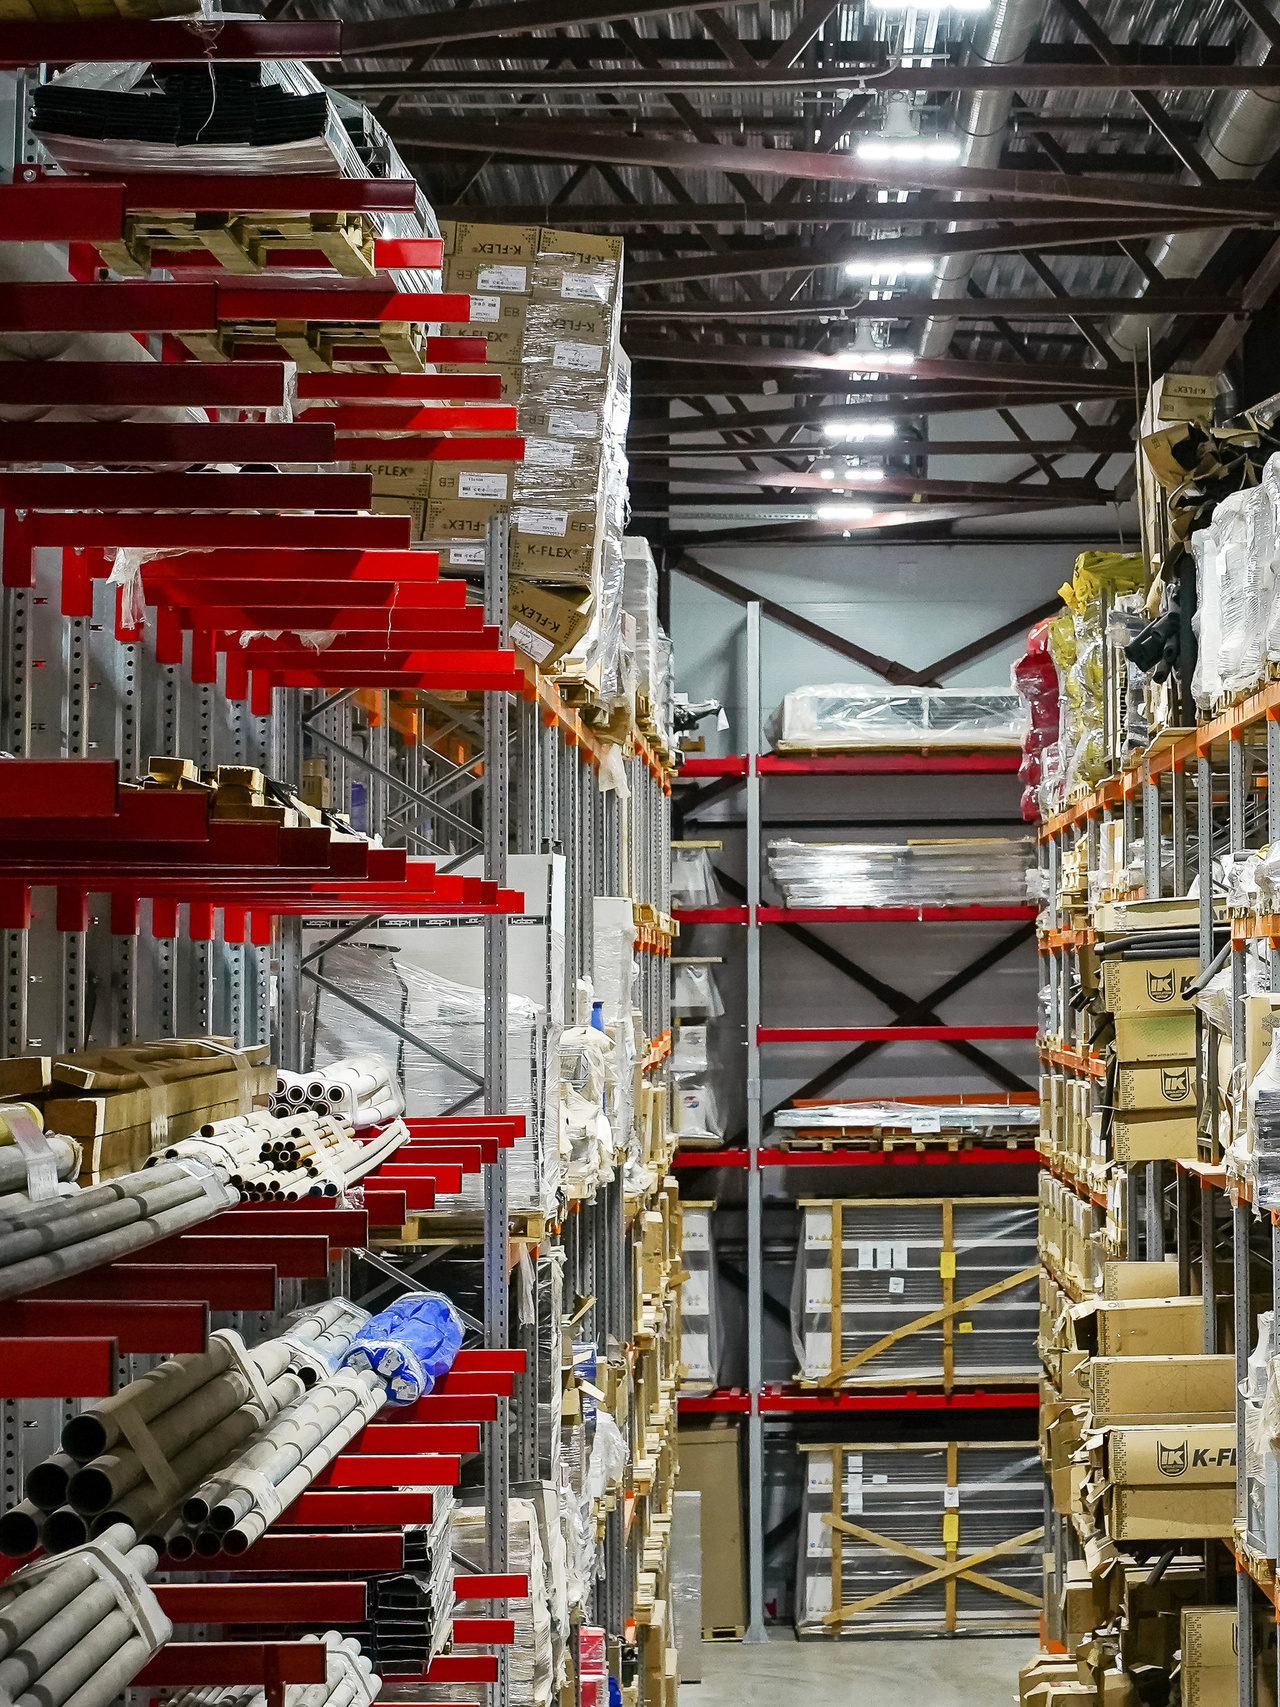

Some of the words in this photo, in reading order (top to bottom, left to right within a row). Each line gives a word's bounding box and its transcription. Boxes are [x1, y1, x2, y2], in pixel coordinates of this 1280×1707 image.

[456, 270, 473, 280] EB
[503, 306, 520, 317] EB
[529, 414, 545, 425] EB
[439, 477, 455, 488] EB
[1192, 1447, 1237, 1467] K-FL
